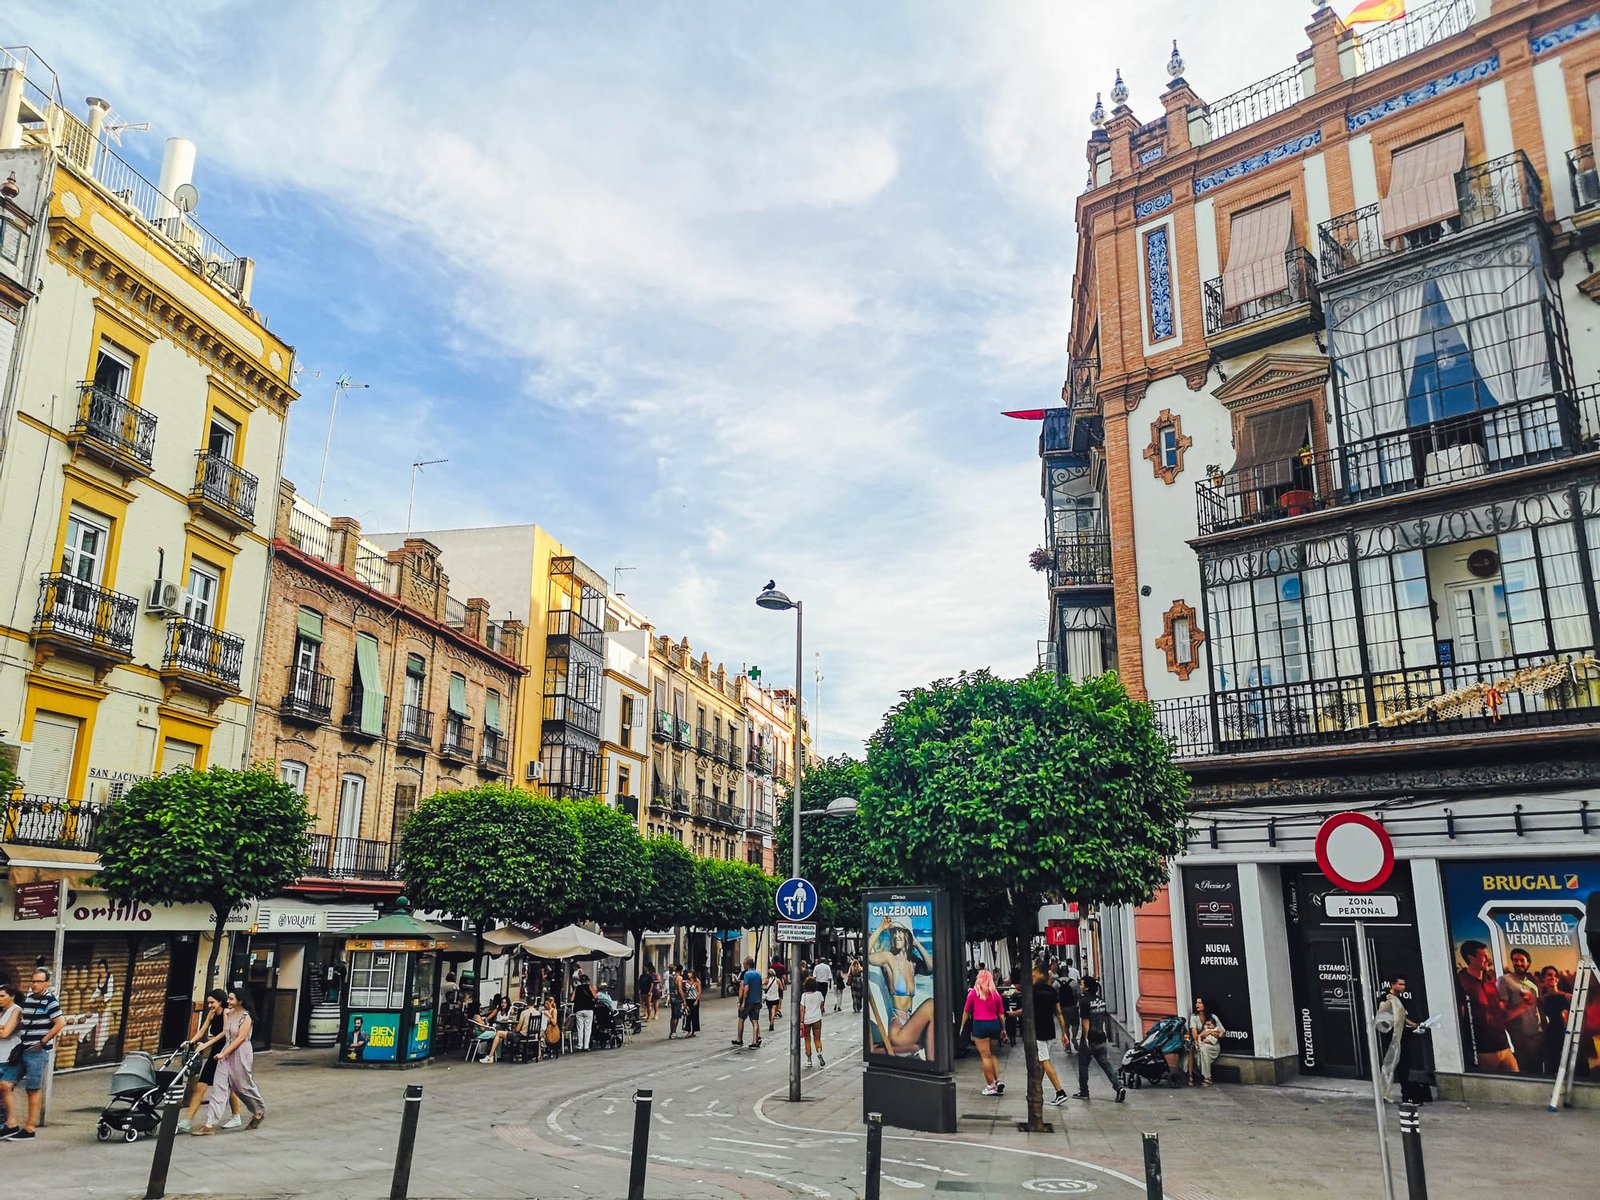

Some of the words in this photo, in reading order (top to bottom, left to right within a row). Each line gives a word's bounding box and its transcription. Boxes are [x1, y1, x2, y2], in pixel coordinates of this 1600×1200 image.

[89, 767, 109, 778] SAN
[1482, 874, 1562, 891] BRUGAL
[1348, 897, 1374, 906] ZONA
[872, 905, 929, 917] CALZEDONIA
[1338, 907, 1386, 915] PEATONAL
[287, 913, 317, 929] VOLAPIÉ
[1508, 912, 1562, 922] Celebrando
[1505, 922, 1520, 933] LA
[1522, 922, 1569, 934] AMISTAD
[1506, 933, 1571, 946] VERDADERA
[1205, 943, 1231, 953] NUEVA
[1200, 956, 1239, 966] APERTURA
[371, 1026, 396, 1036] BIEN
[367, 1035, 395, 1047] JUGADO
[1301, 1008, 1316, 1067] Cruzcampo
